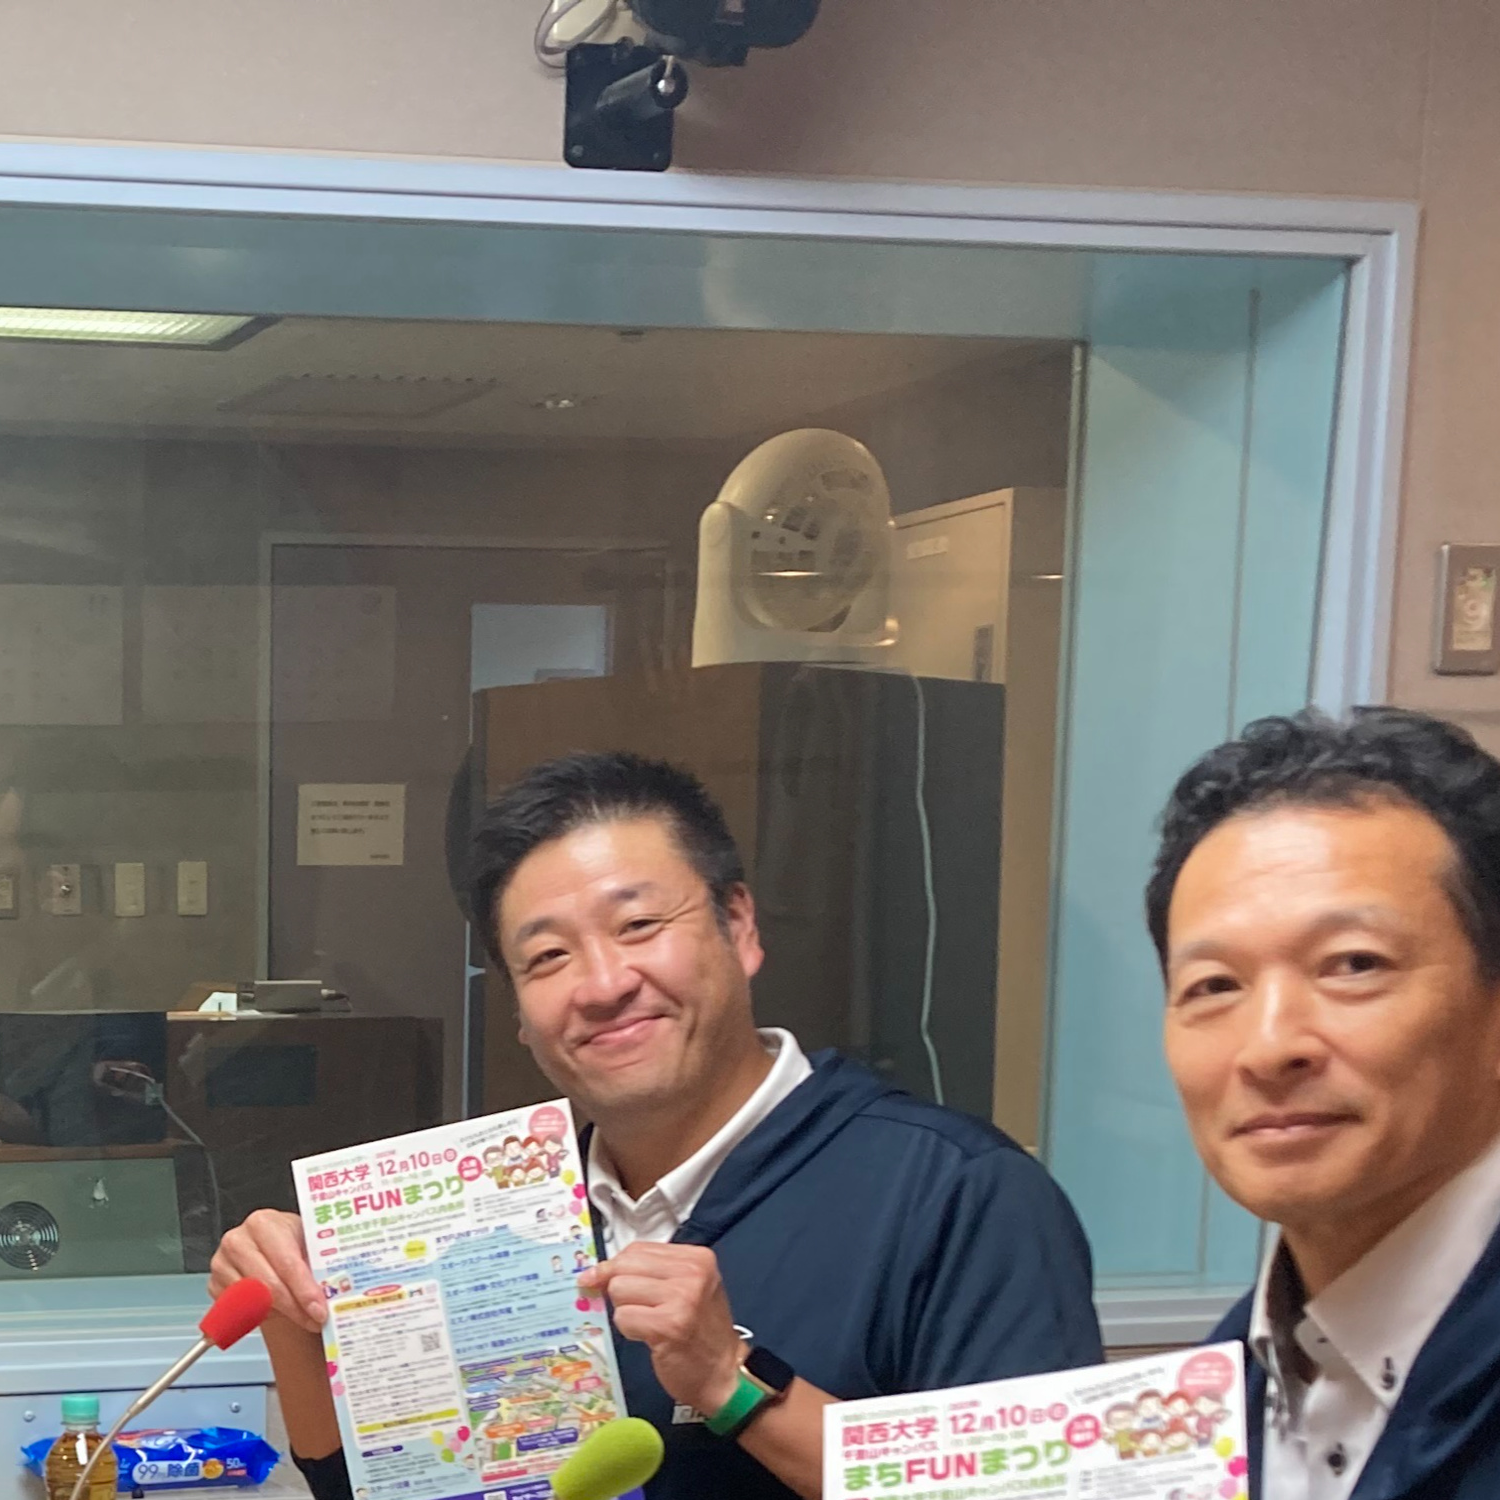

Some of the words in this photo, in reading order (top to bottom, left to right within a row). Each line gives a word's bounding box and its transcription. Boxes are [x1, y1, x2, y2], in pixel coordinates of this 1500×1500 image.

[308, 1164, 371, 1192] 関西大学
[314, 1175, 465, 1225] まちFUNまつり
[843, 1439, 1071, 1491] まちFUNまつり
